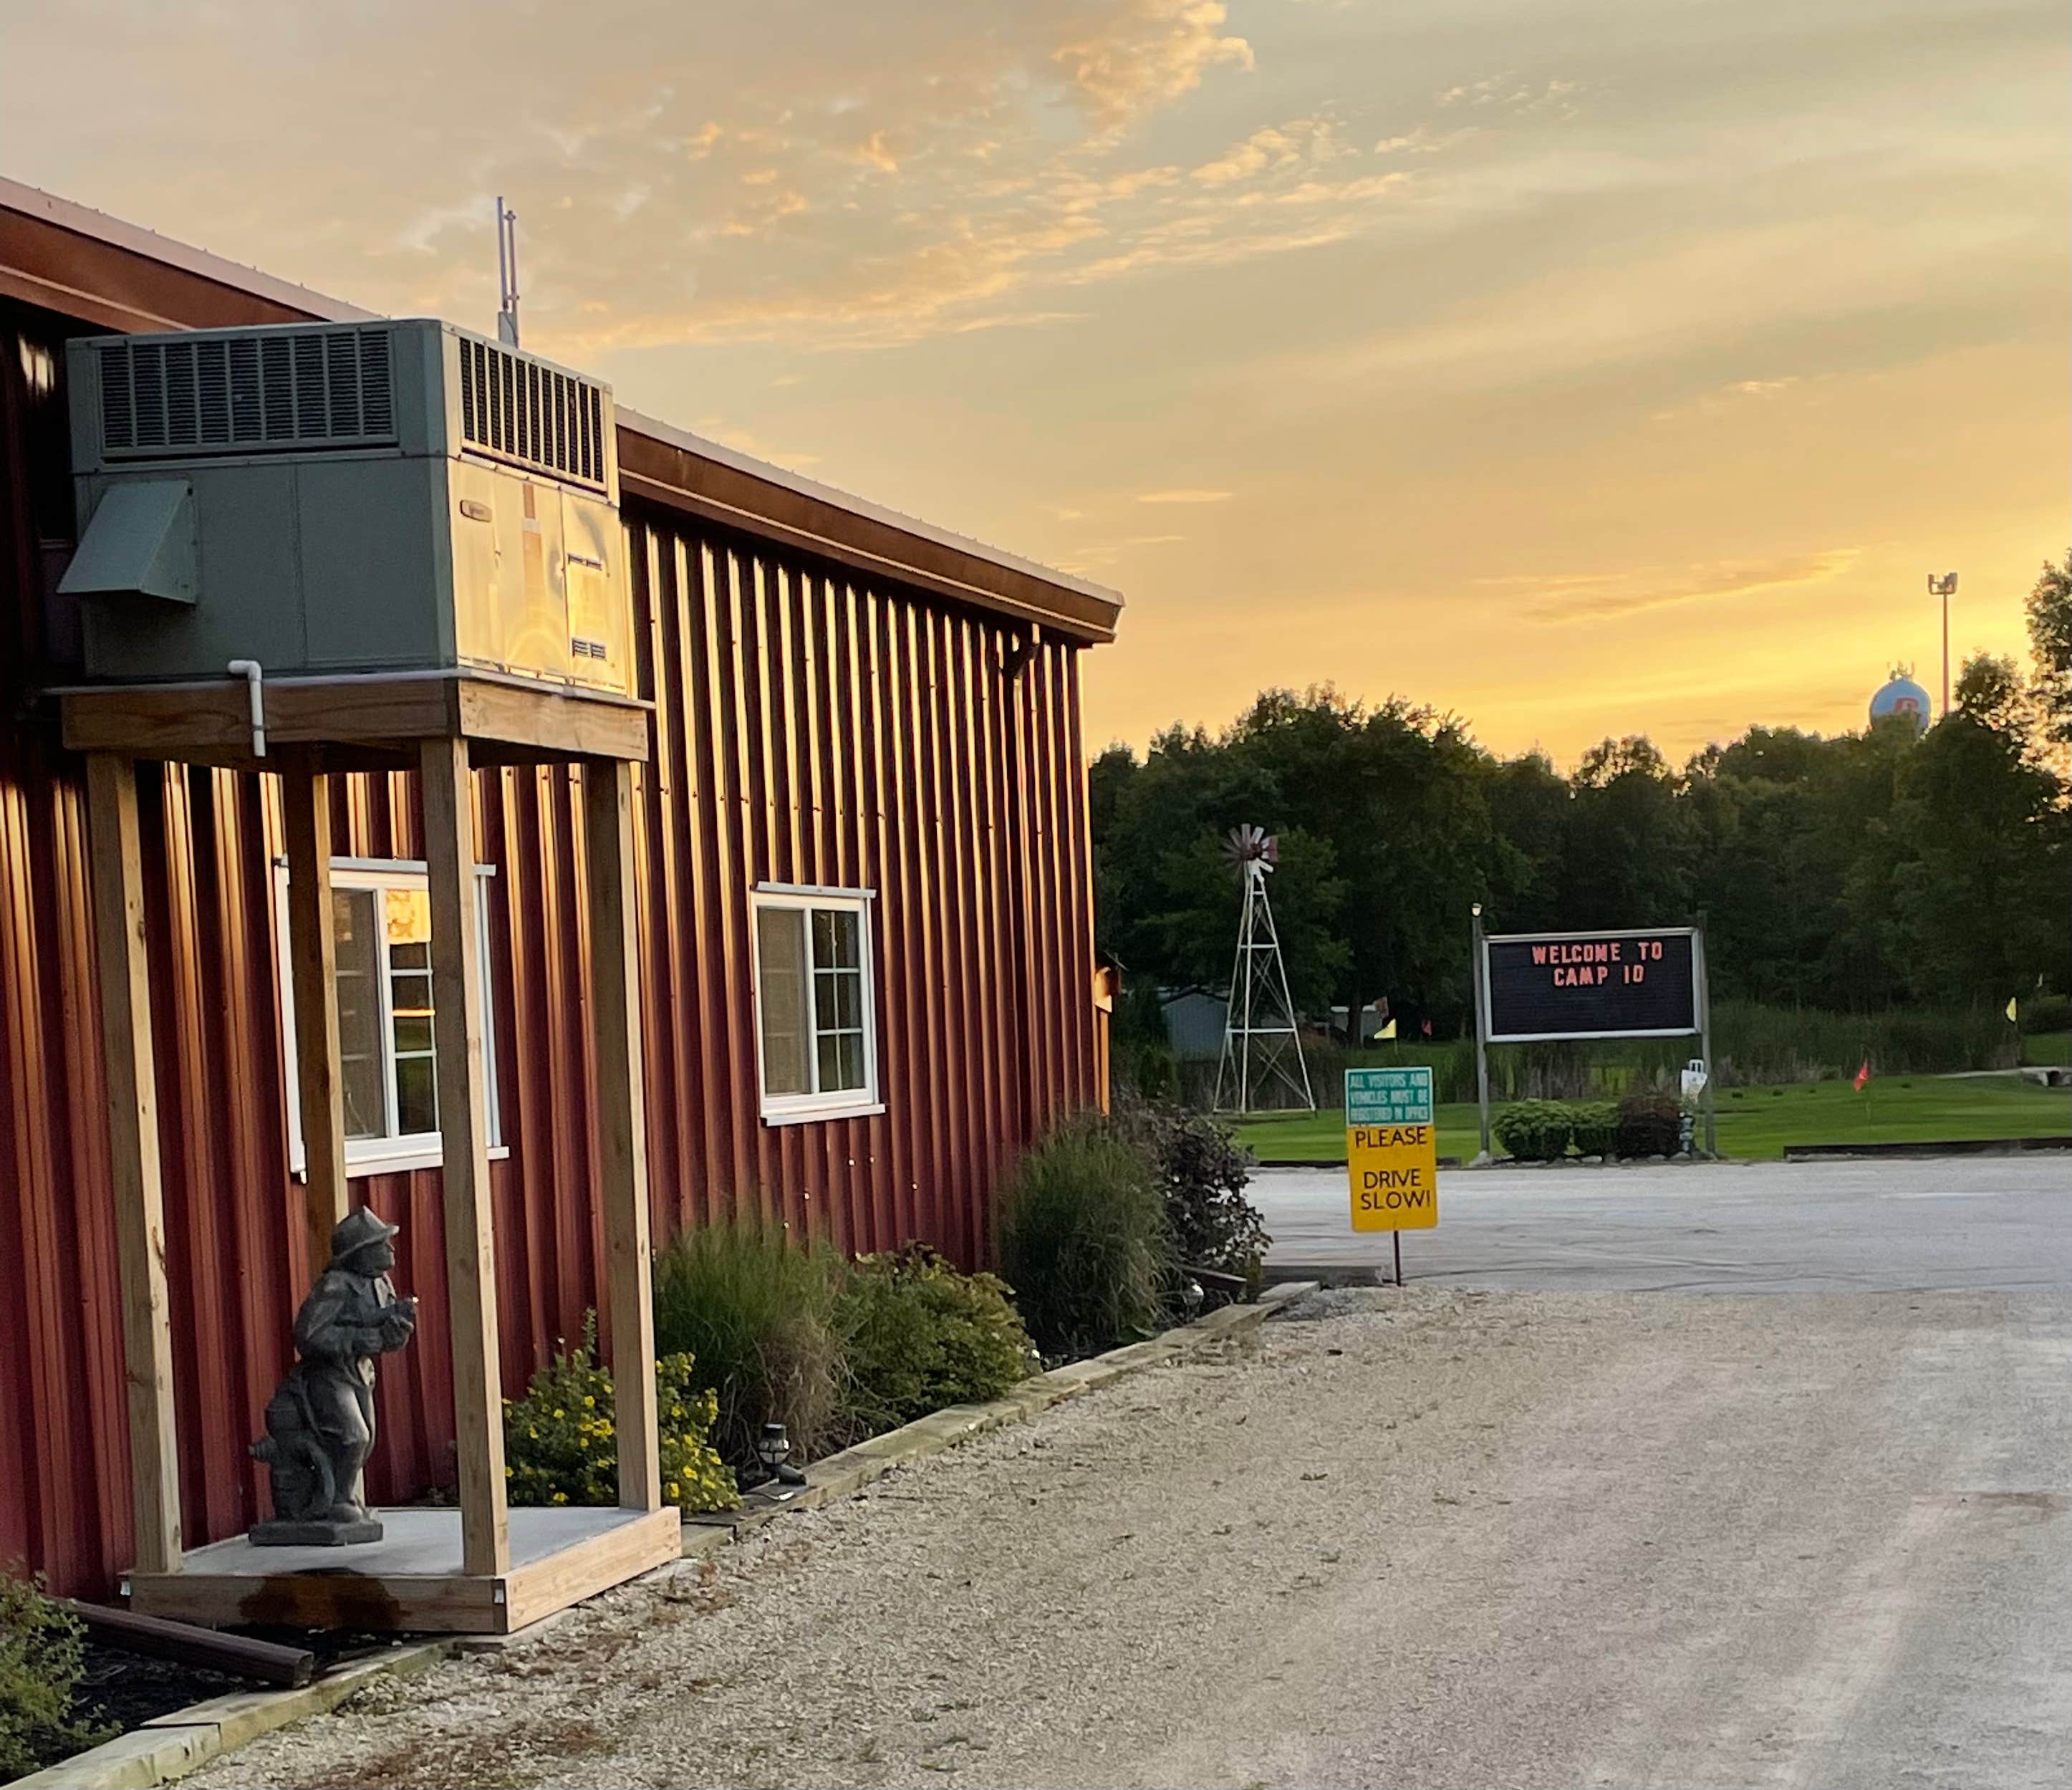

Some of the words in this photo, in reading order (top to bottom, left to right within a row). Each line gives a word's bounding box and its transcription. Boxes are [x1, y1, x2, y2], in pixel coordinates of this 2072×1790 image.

[1532, 942, 1622, 965] WELCOME
[1638, 941, 1663, 961] TO
[1553, 966, 1609, 986] CAMP
[1349, 1074, 1364, 1088] ALL
[1368, 1074, 1407, 1088] VISITORS
[1418, 1089, 1428, 1103] BE
[1394, 1107, 1403, 1120] IN
[1355, 1126, 1427, 1148] PLEASE
[1363, 1168, 1421, 1189] DRIVE
